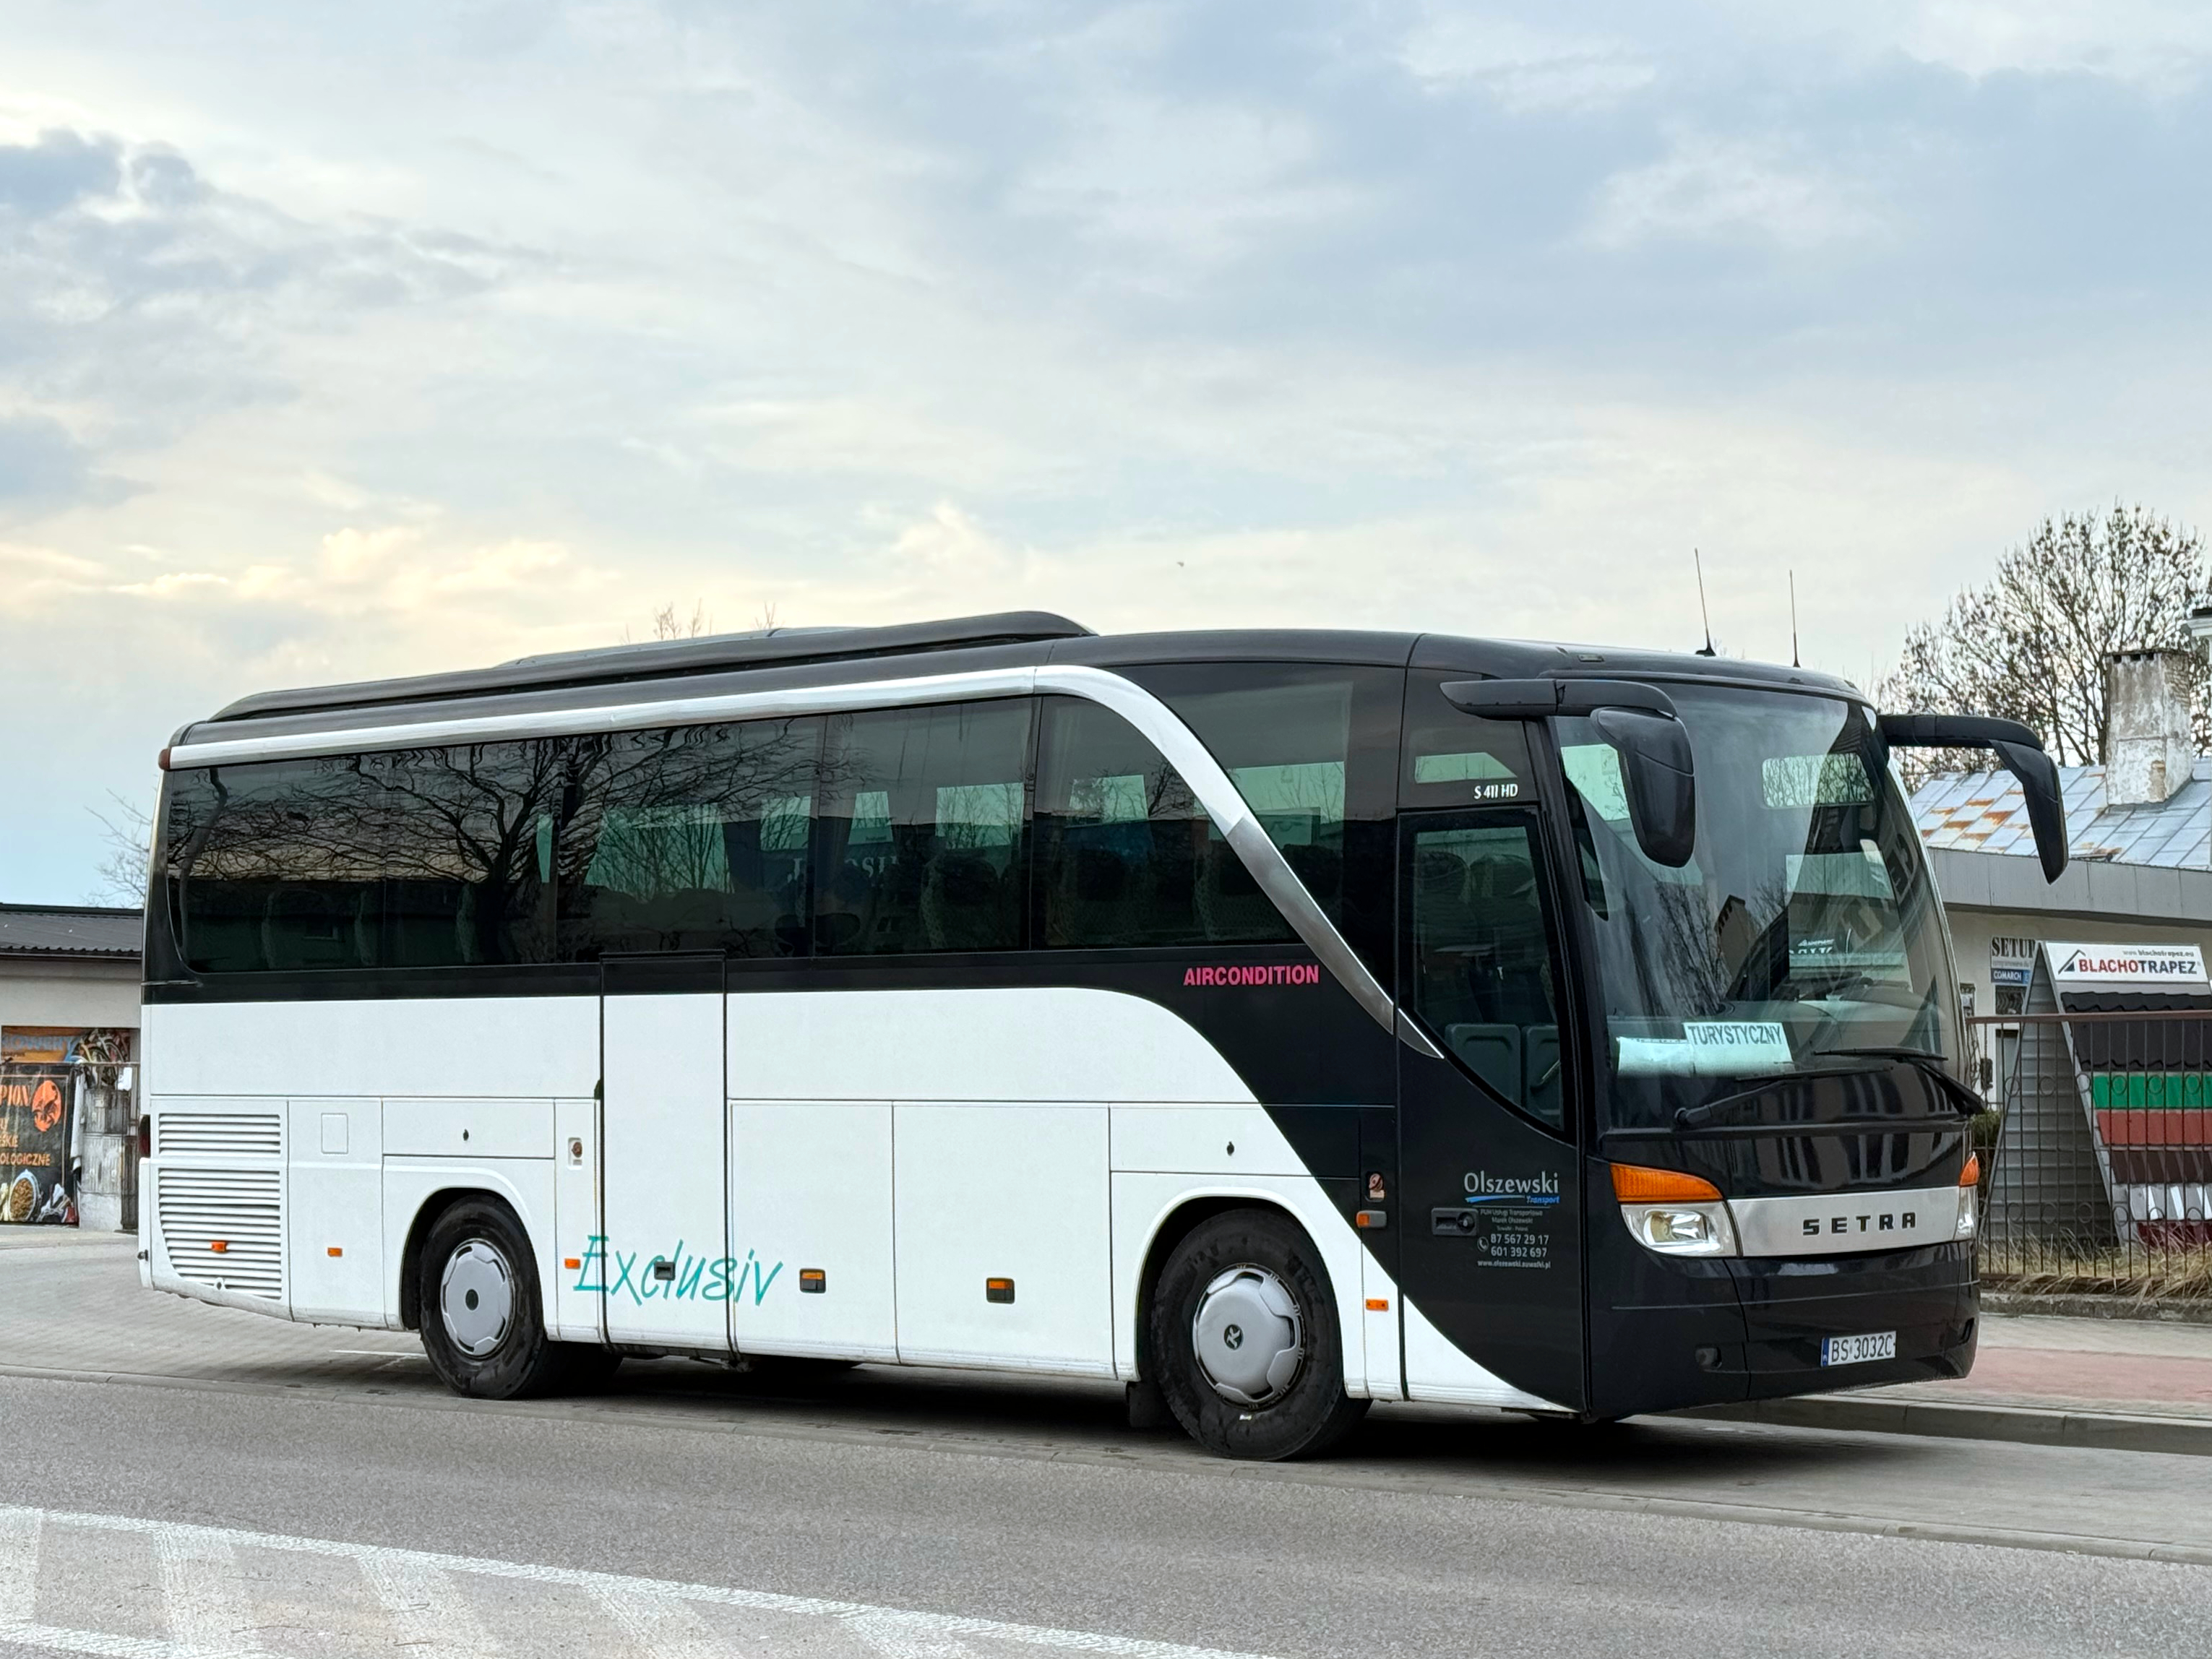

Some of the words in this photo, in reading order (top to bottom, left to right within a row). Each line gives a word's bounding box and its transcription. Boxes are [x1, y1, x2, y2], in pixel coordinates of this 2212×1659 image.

[1473, 785, 1482, 800] S
[1483, 784, 1499, 799] 411
[1501, 783, 1518, 798] HD
[1183, 965, 1320, 986] AIRCONDITION
[1993, 970, 2022, 981] COMARCH
[2078, 959, 2198, 975] BLACHOTRAPEZ
[1687, 1025, 1783, 1046] TURYSTYCZNY
[1463, 1170, 1559, 1194] Olszewski
[1526, 1194, 1561, 1206] Transport
[1802, 1212, 1916, 1236] SETRA
[1490, 1233, 1502, 1244] 87
[1504, 1233, 1522, 1244] 567
[1524, 1234, 1536, 1245] 29
[1538, 1235, 1549, 1245] 17
[1491, 1246, 1508, 1257] 601
[1510, 1246, 1528, 1257] 392
[1529, 1247, 1547, 1258] 697
[572, 1234, 784, 1307] Exclusiv
[1831, 1339, 1849, 1363] BS
[1854, 1334, 1893, 1361] 3032C
